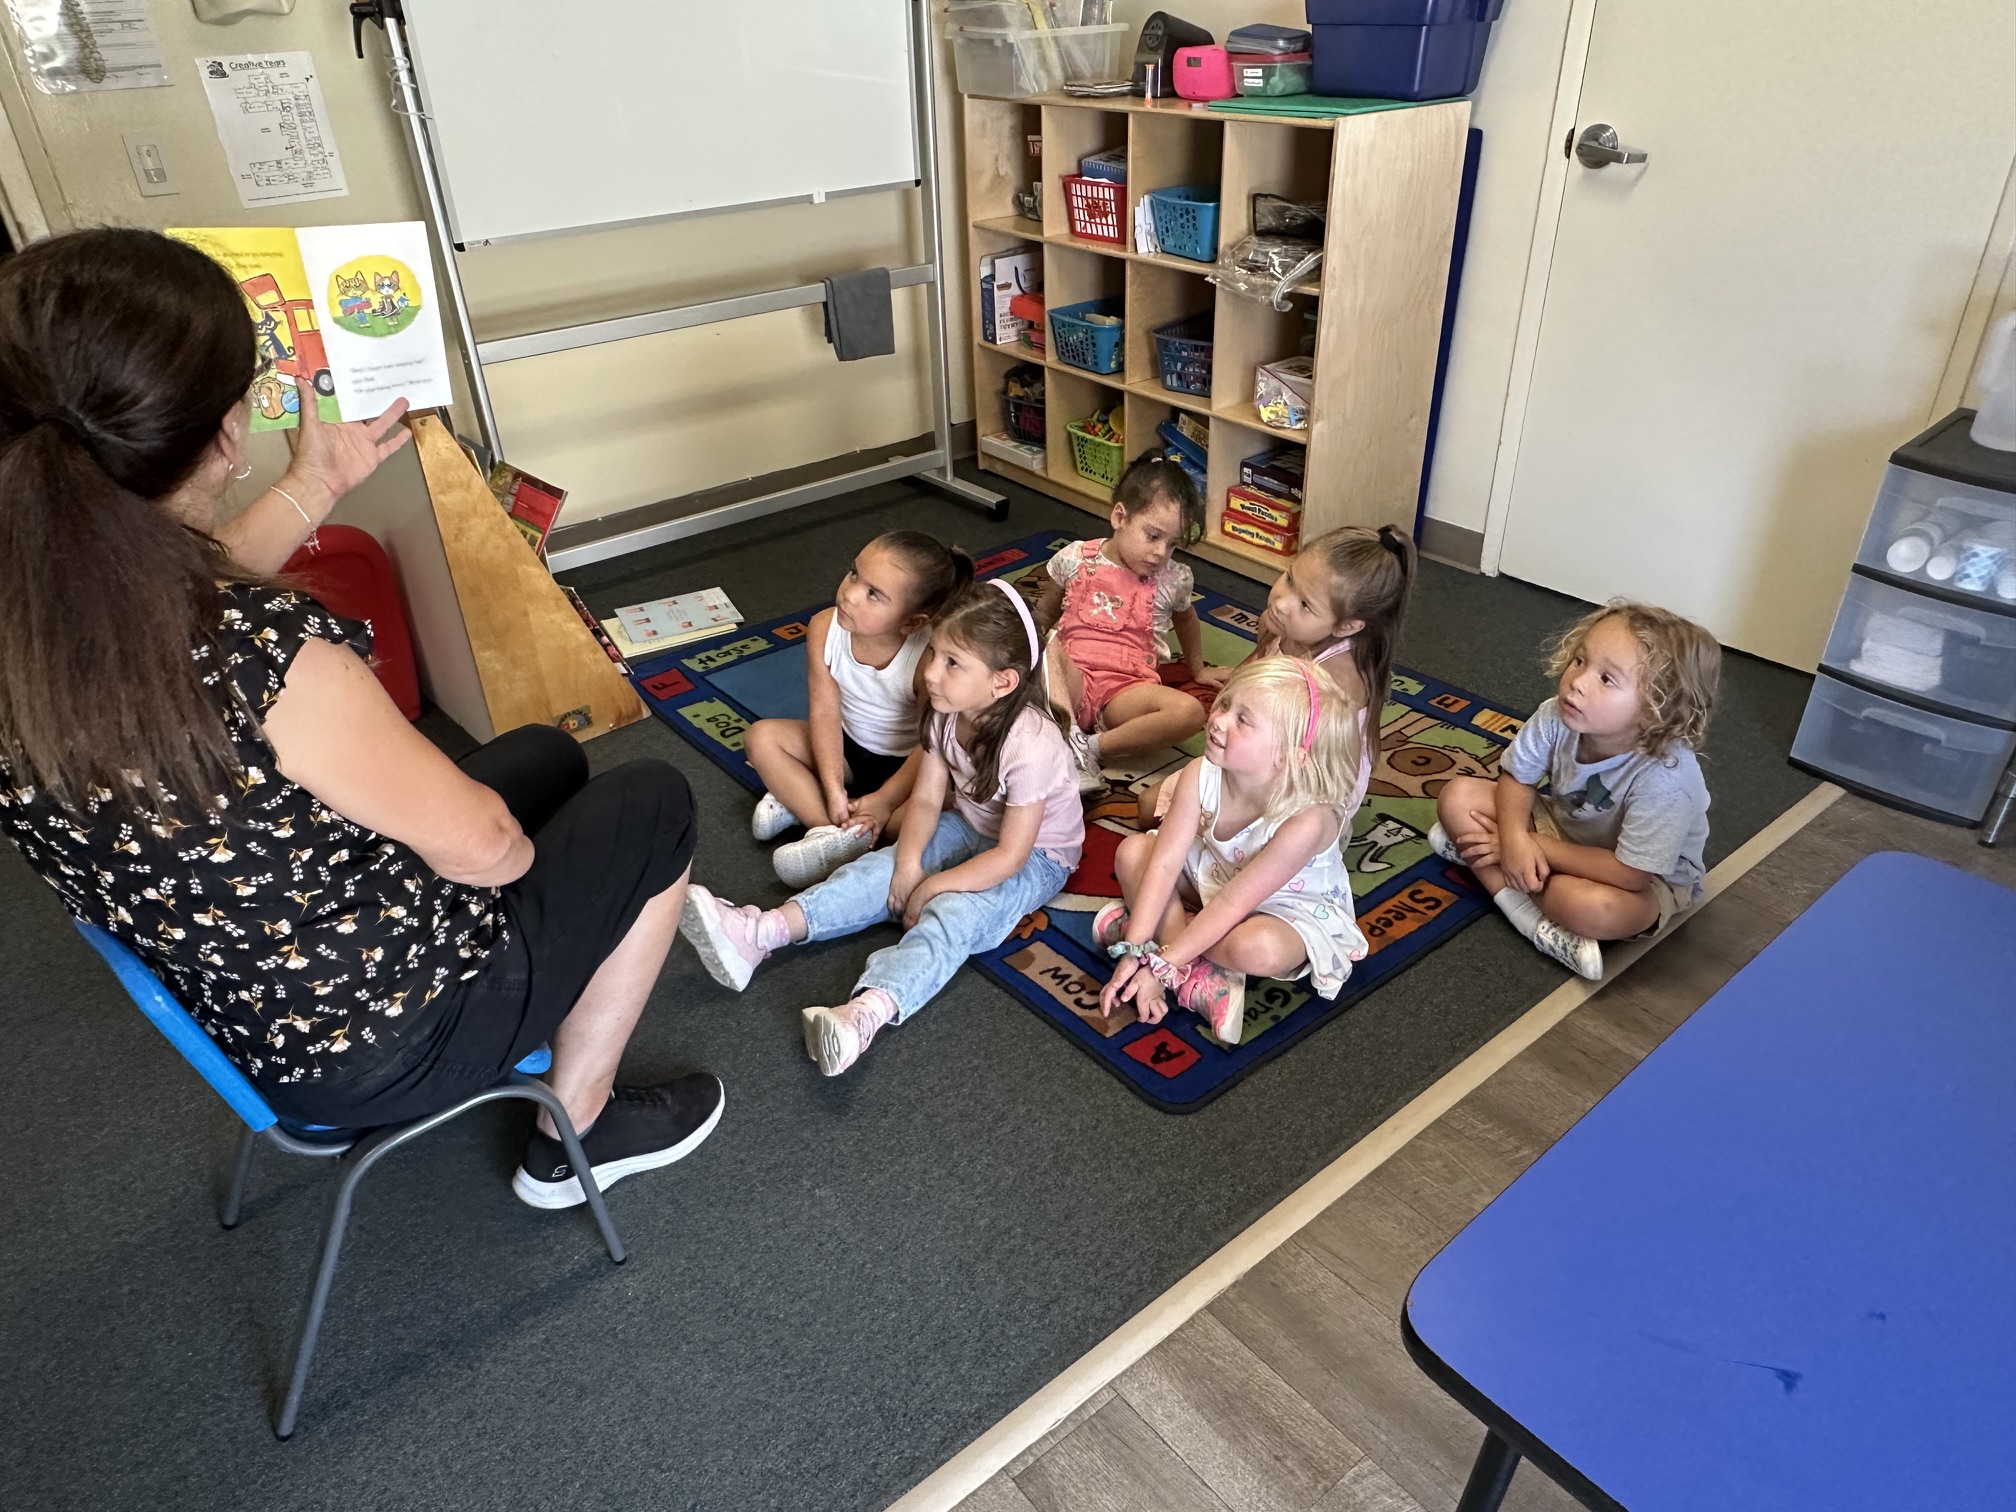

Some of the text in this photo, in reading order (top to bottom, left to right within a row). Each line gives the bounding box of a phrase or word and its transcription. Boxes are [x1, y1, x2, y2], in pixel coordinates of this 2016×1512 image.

[229, 61, 263, 70] Creative
[697, 643, 751, 666] Horse
[705, 713, 747, 739] Dog
[1366, 888, 1442, 938] Sheep
[1039, 966, 1102, 1011] Cow
[1150, 1041, 1187, 1065] A
